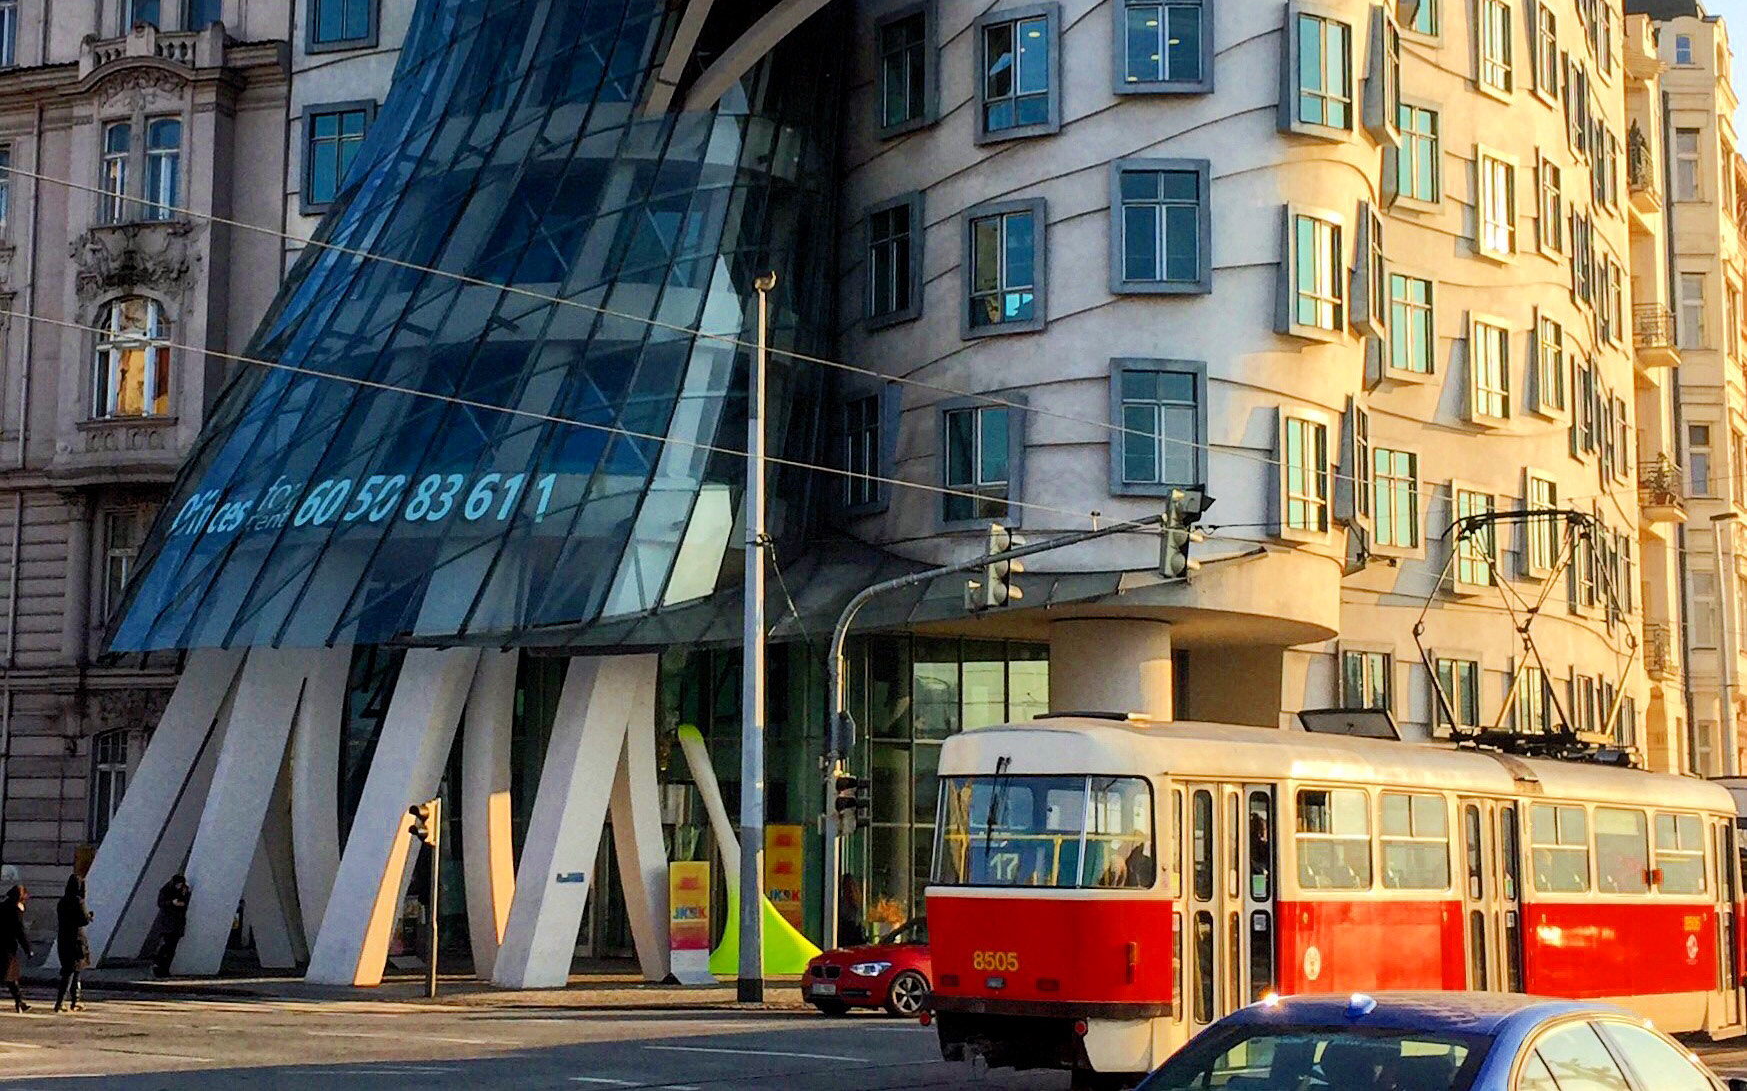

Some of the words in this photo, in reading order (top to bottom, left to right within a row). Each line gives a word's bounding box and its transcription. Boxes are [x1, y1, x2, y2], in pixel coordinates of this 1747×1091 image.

[171, 489, 253, 536] Offices
[990, 852, 1019, 880] 17
[973, 951, 1019, 971] 8505
